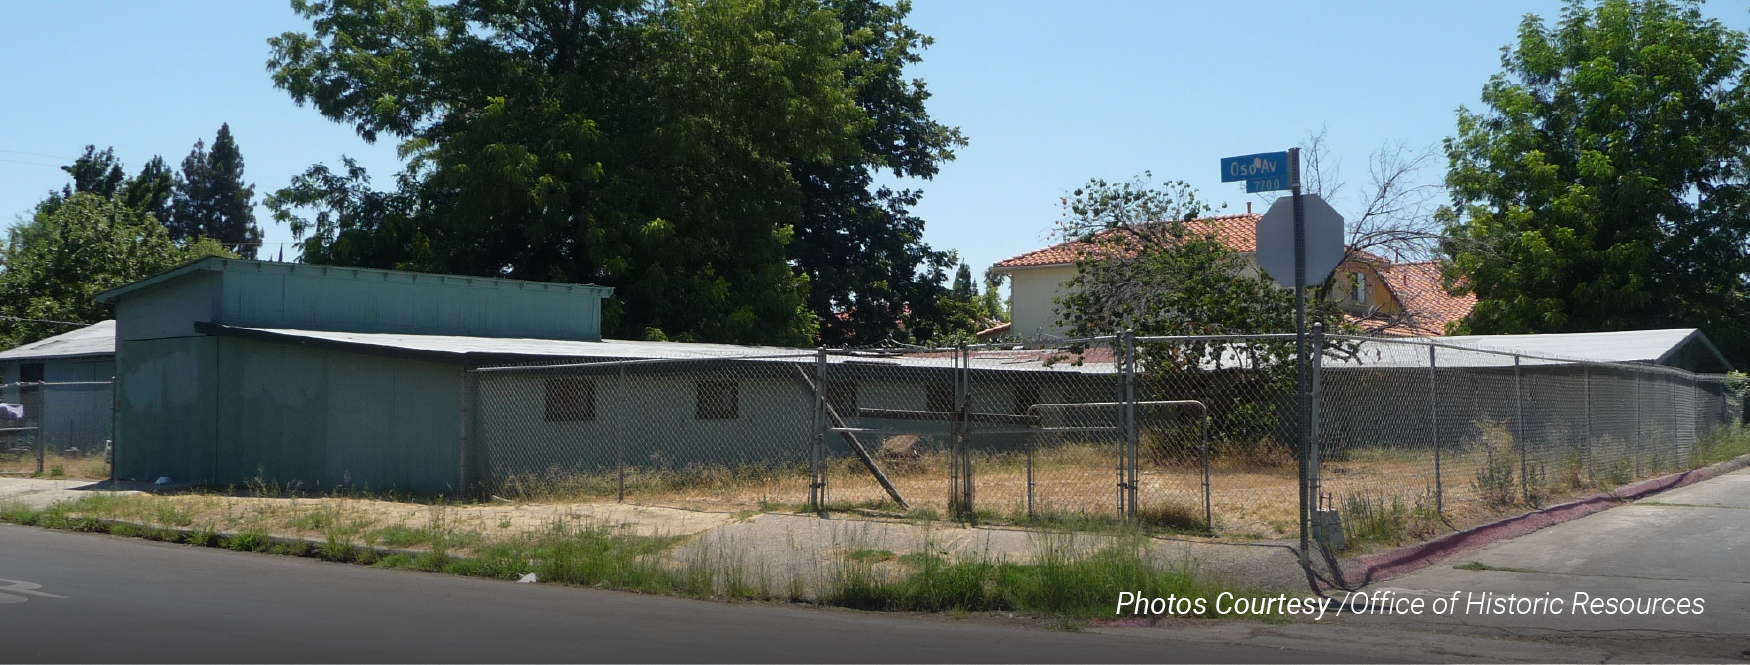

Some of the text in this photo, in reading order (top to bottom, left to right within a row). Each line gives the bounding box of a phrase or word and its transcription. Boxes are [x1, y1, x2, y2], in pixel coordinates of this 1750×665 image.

[1230, 159, 1277, 176] Oso Av
[1254, 179, 1280, 191] 7700
